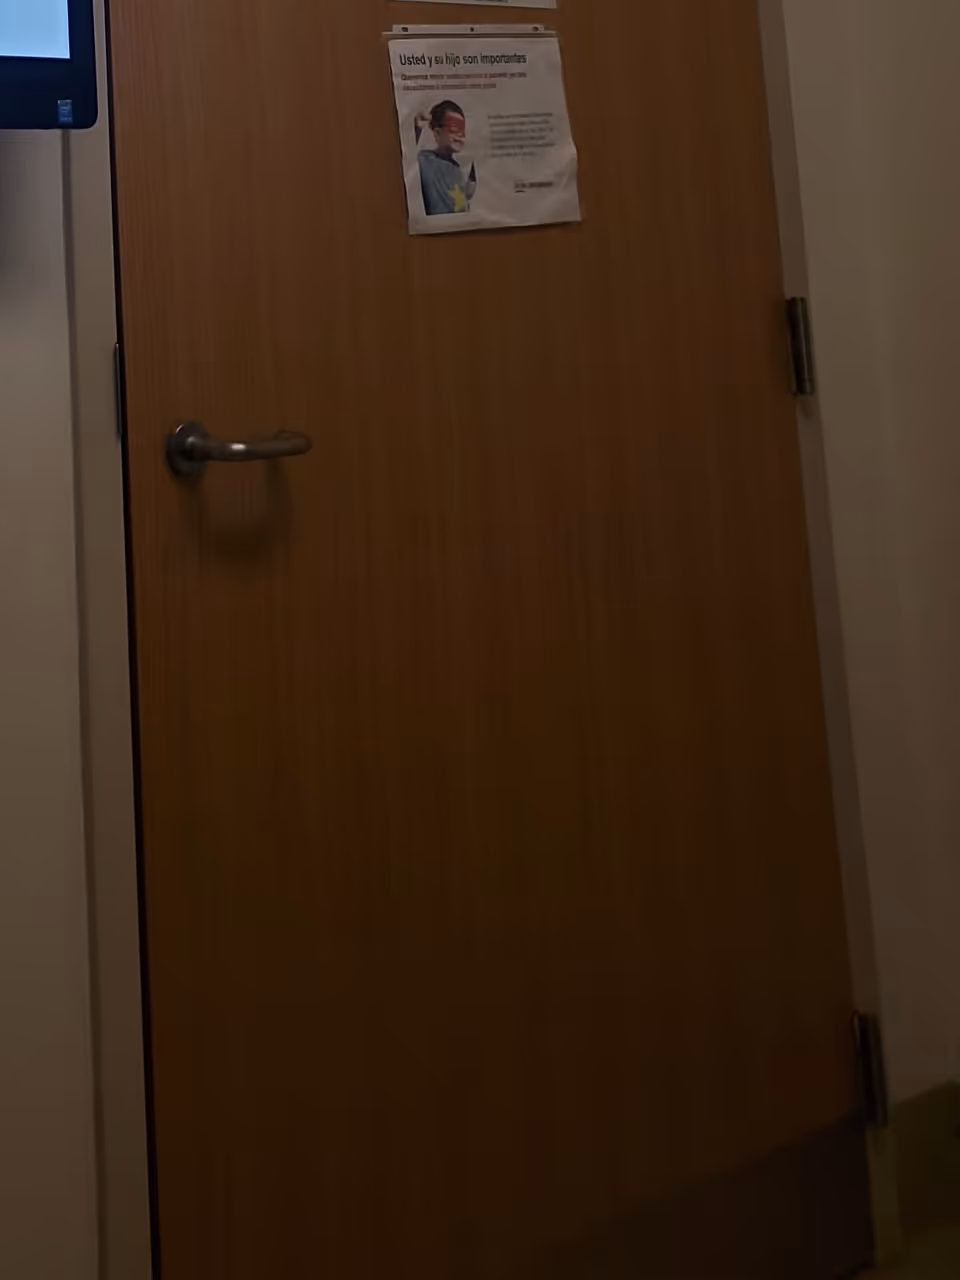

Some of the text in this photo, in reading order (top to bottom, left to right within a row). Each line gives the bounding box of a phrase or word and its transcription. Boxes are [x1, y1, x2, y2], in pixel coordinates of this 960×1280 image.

[400, 52, 527, 67] Usted y su hijo son importantes
